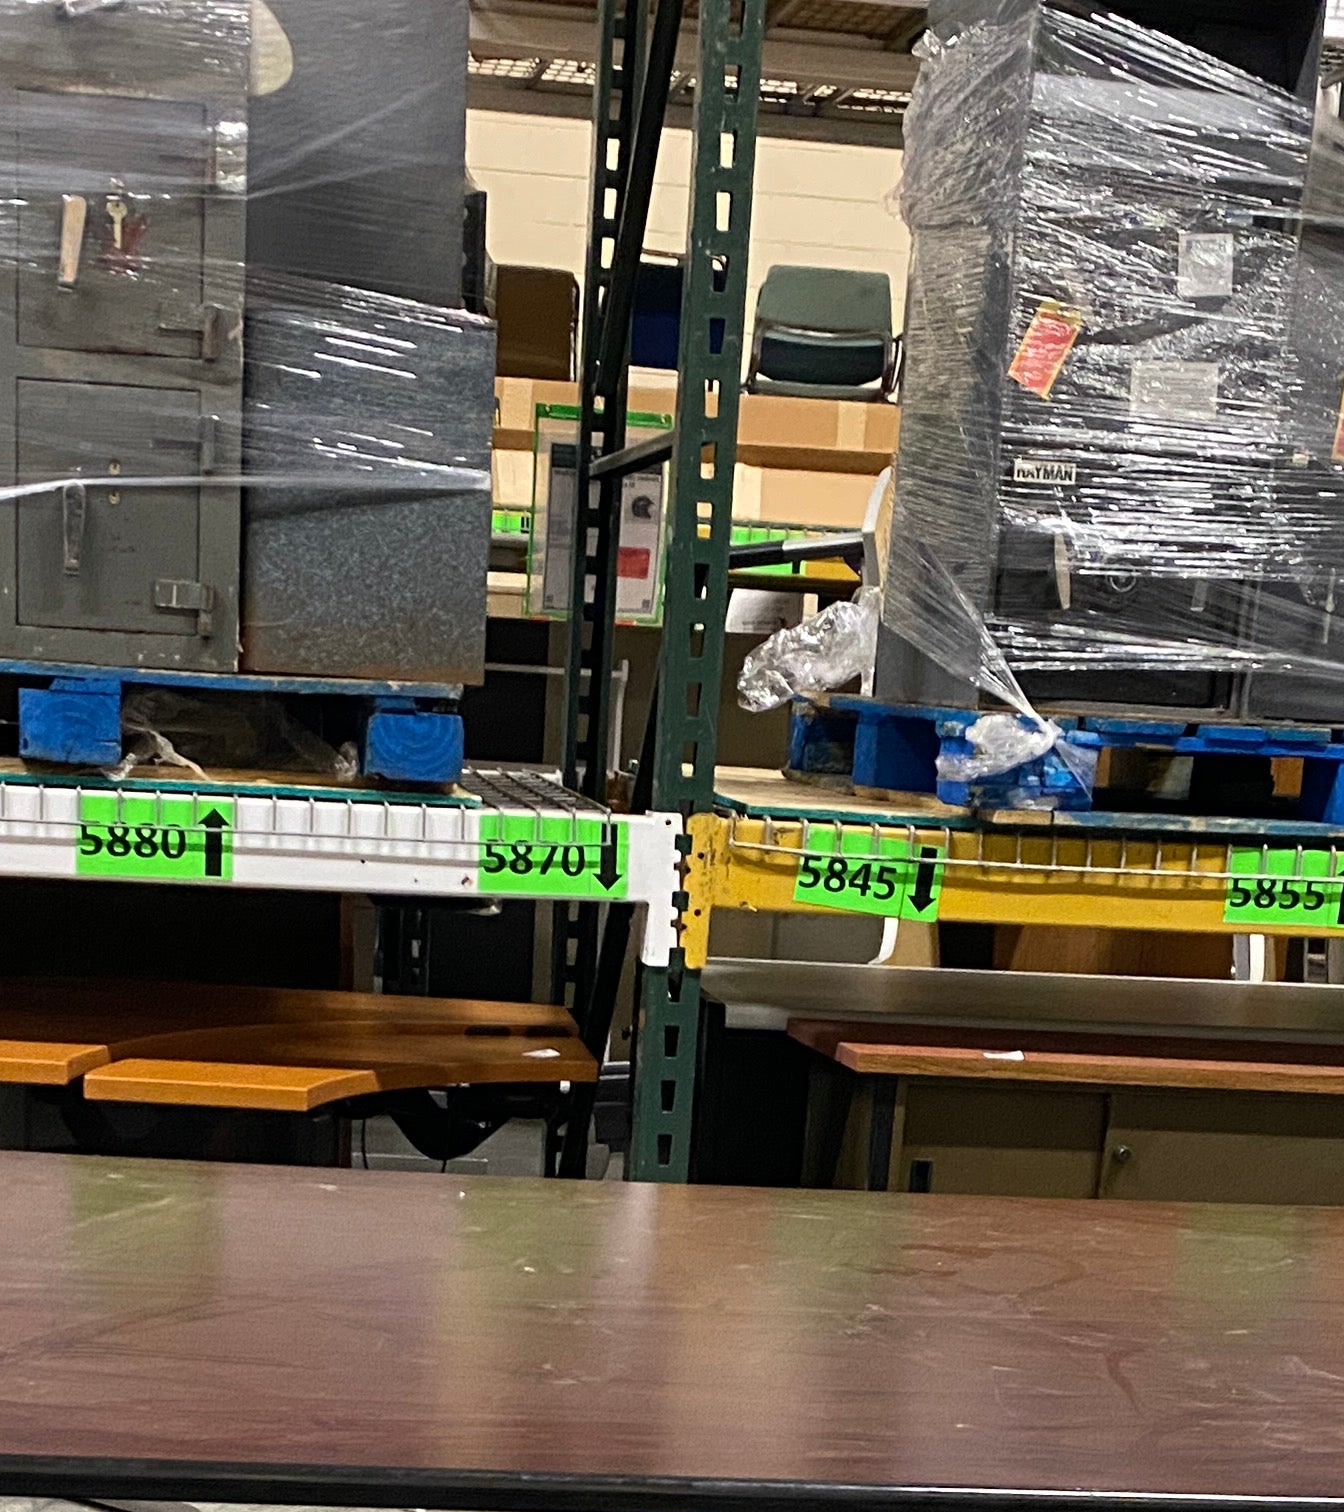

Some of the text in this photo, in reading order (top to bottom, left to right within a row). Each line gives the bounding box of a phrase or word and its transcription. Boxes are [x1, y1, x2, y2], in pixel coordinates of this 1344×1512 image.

[80, 819, 187, 859] 5880
[483, 838, 586, 877] 5870
[798, 854, 898, 900] 5845
[1229, 876, 1325, 911] 5855
